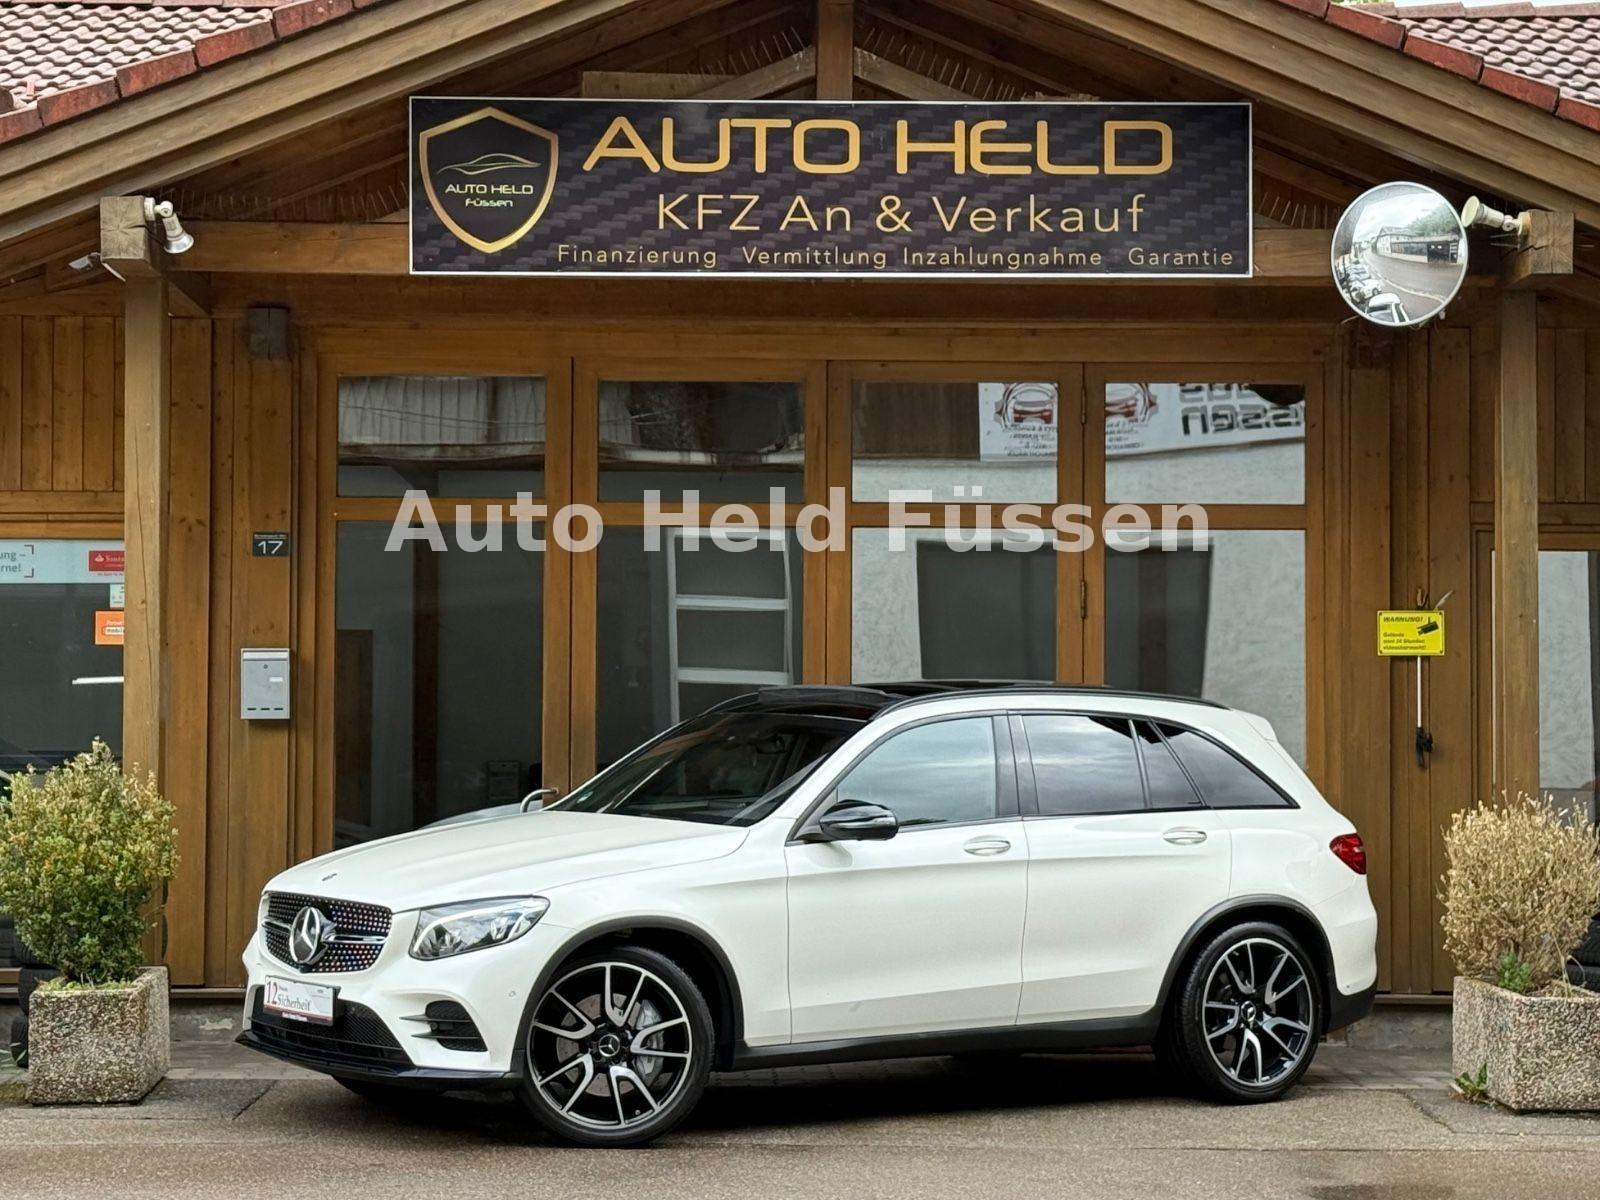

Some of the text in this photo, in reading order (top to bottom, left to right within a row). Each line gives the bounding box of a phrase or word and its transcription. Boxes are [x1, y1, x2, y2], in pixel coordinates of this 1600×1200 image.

[582, 116, 1173, 175] AUTO HELD
[445, 184, 534, 195] AUTO HELD
[658, 193, 1146, 233] KFZ An & Verkauf
[557, 244, 1234, 270] Finanzierung Vermittlung Inzahlungnahme Garantie
[257, 540, 284, 555] 17
[266, 981, 278, 1005] 12
